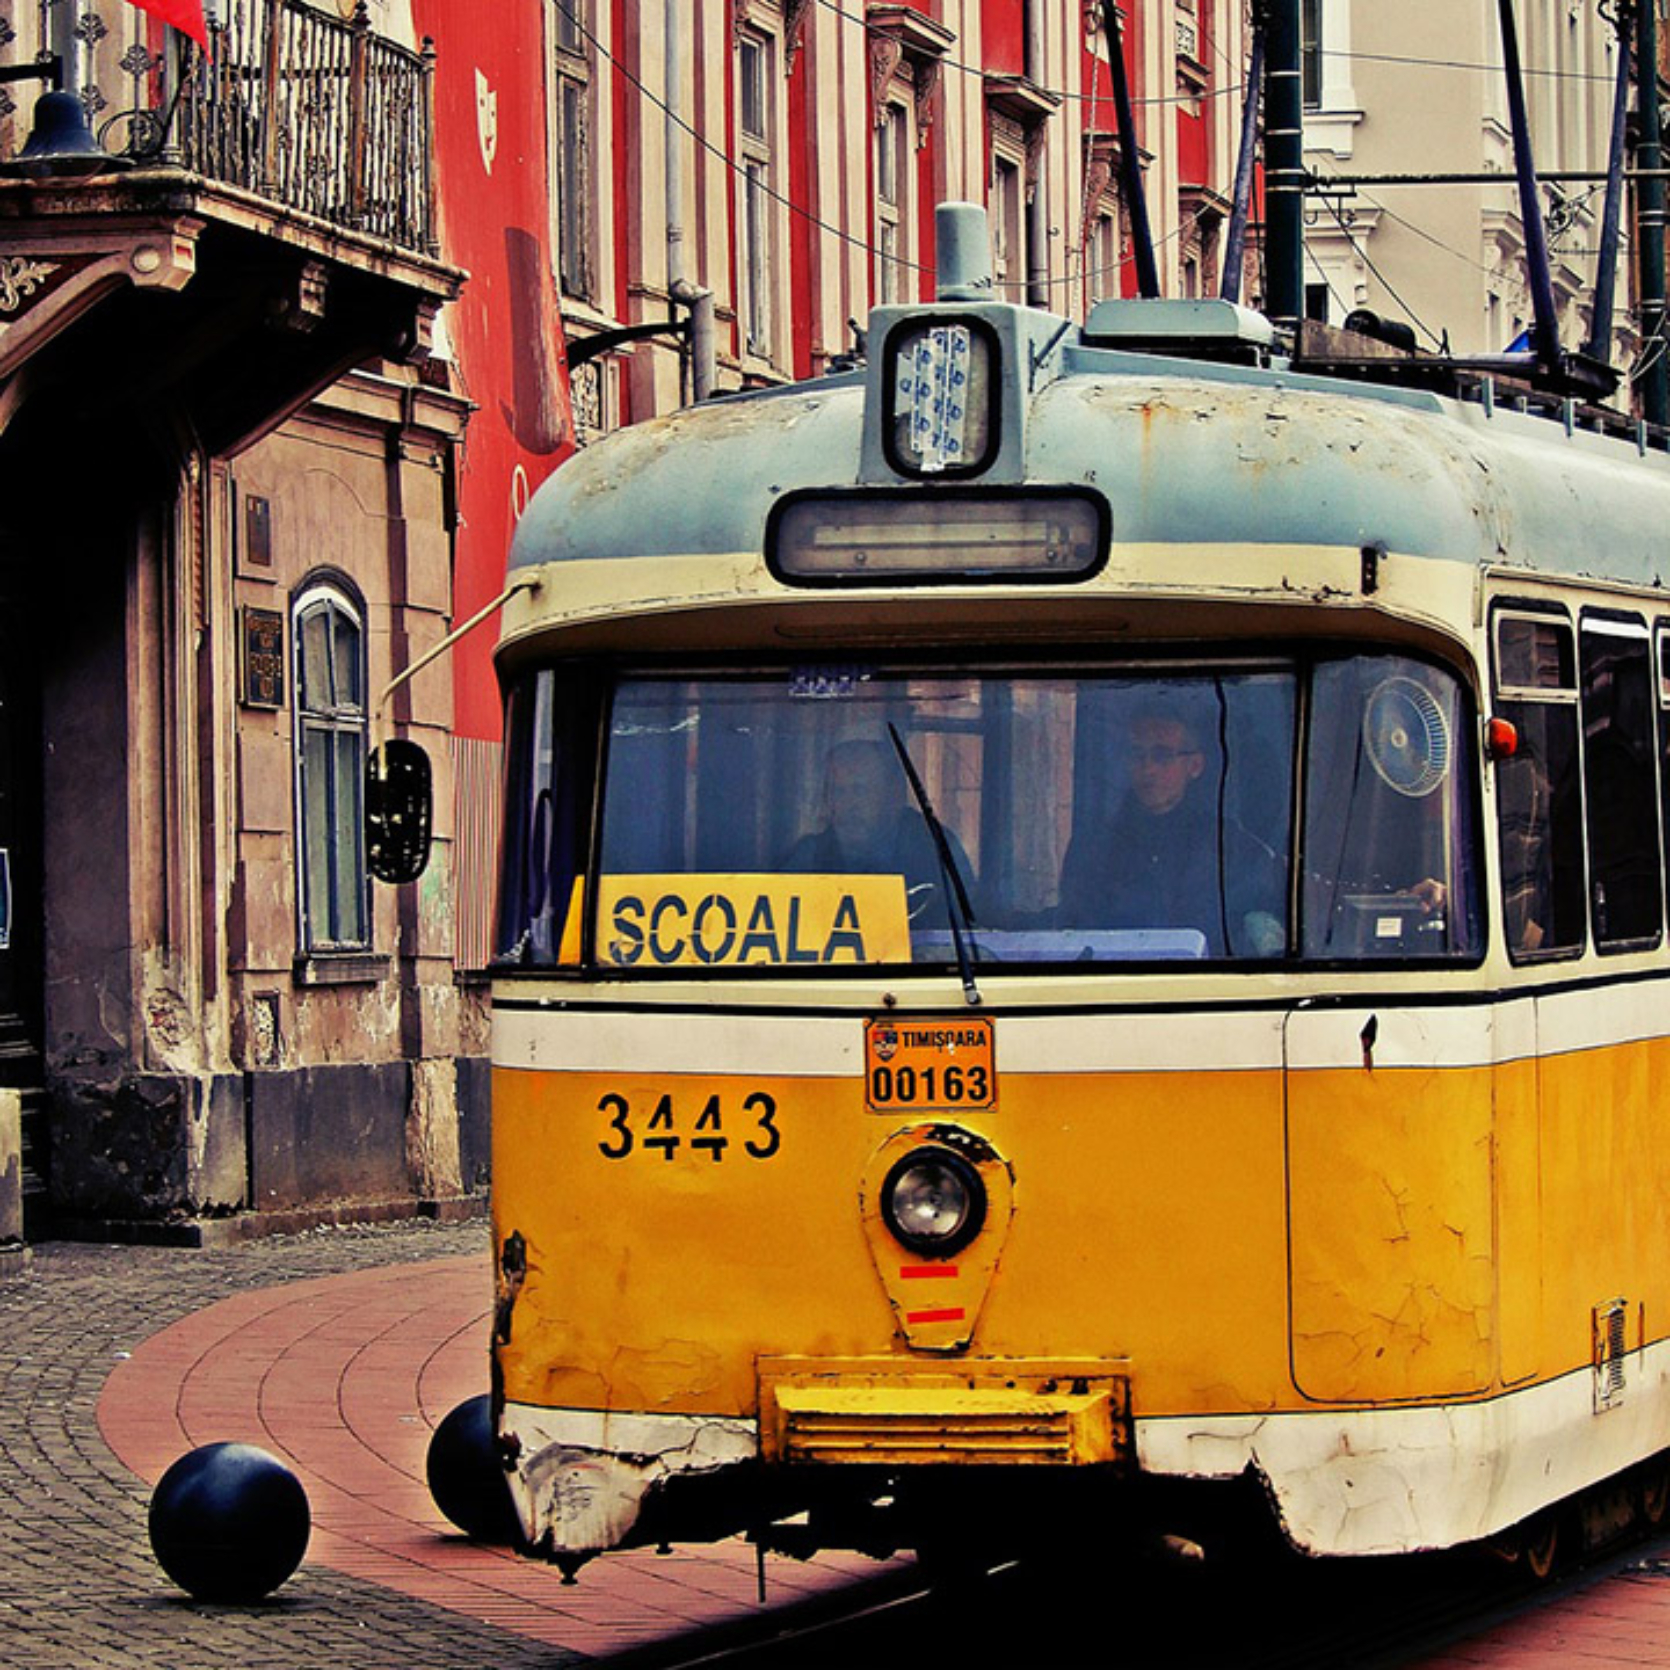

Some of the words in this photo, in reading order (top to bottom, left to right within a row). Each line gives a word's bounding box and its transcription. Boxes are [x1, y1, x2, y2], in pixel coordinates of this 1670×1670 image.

[609, 894, 867, 964] SCOALA
[873, 1066, 988, 1102] 00163
[597, 1092, 780, 1162] 3443
